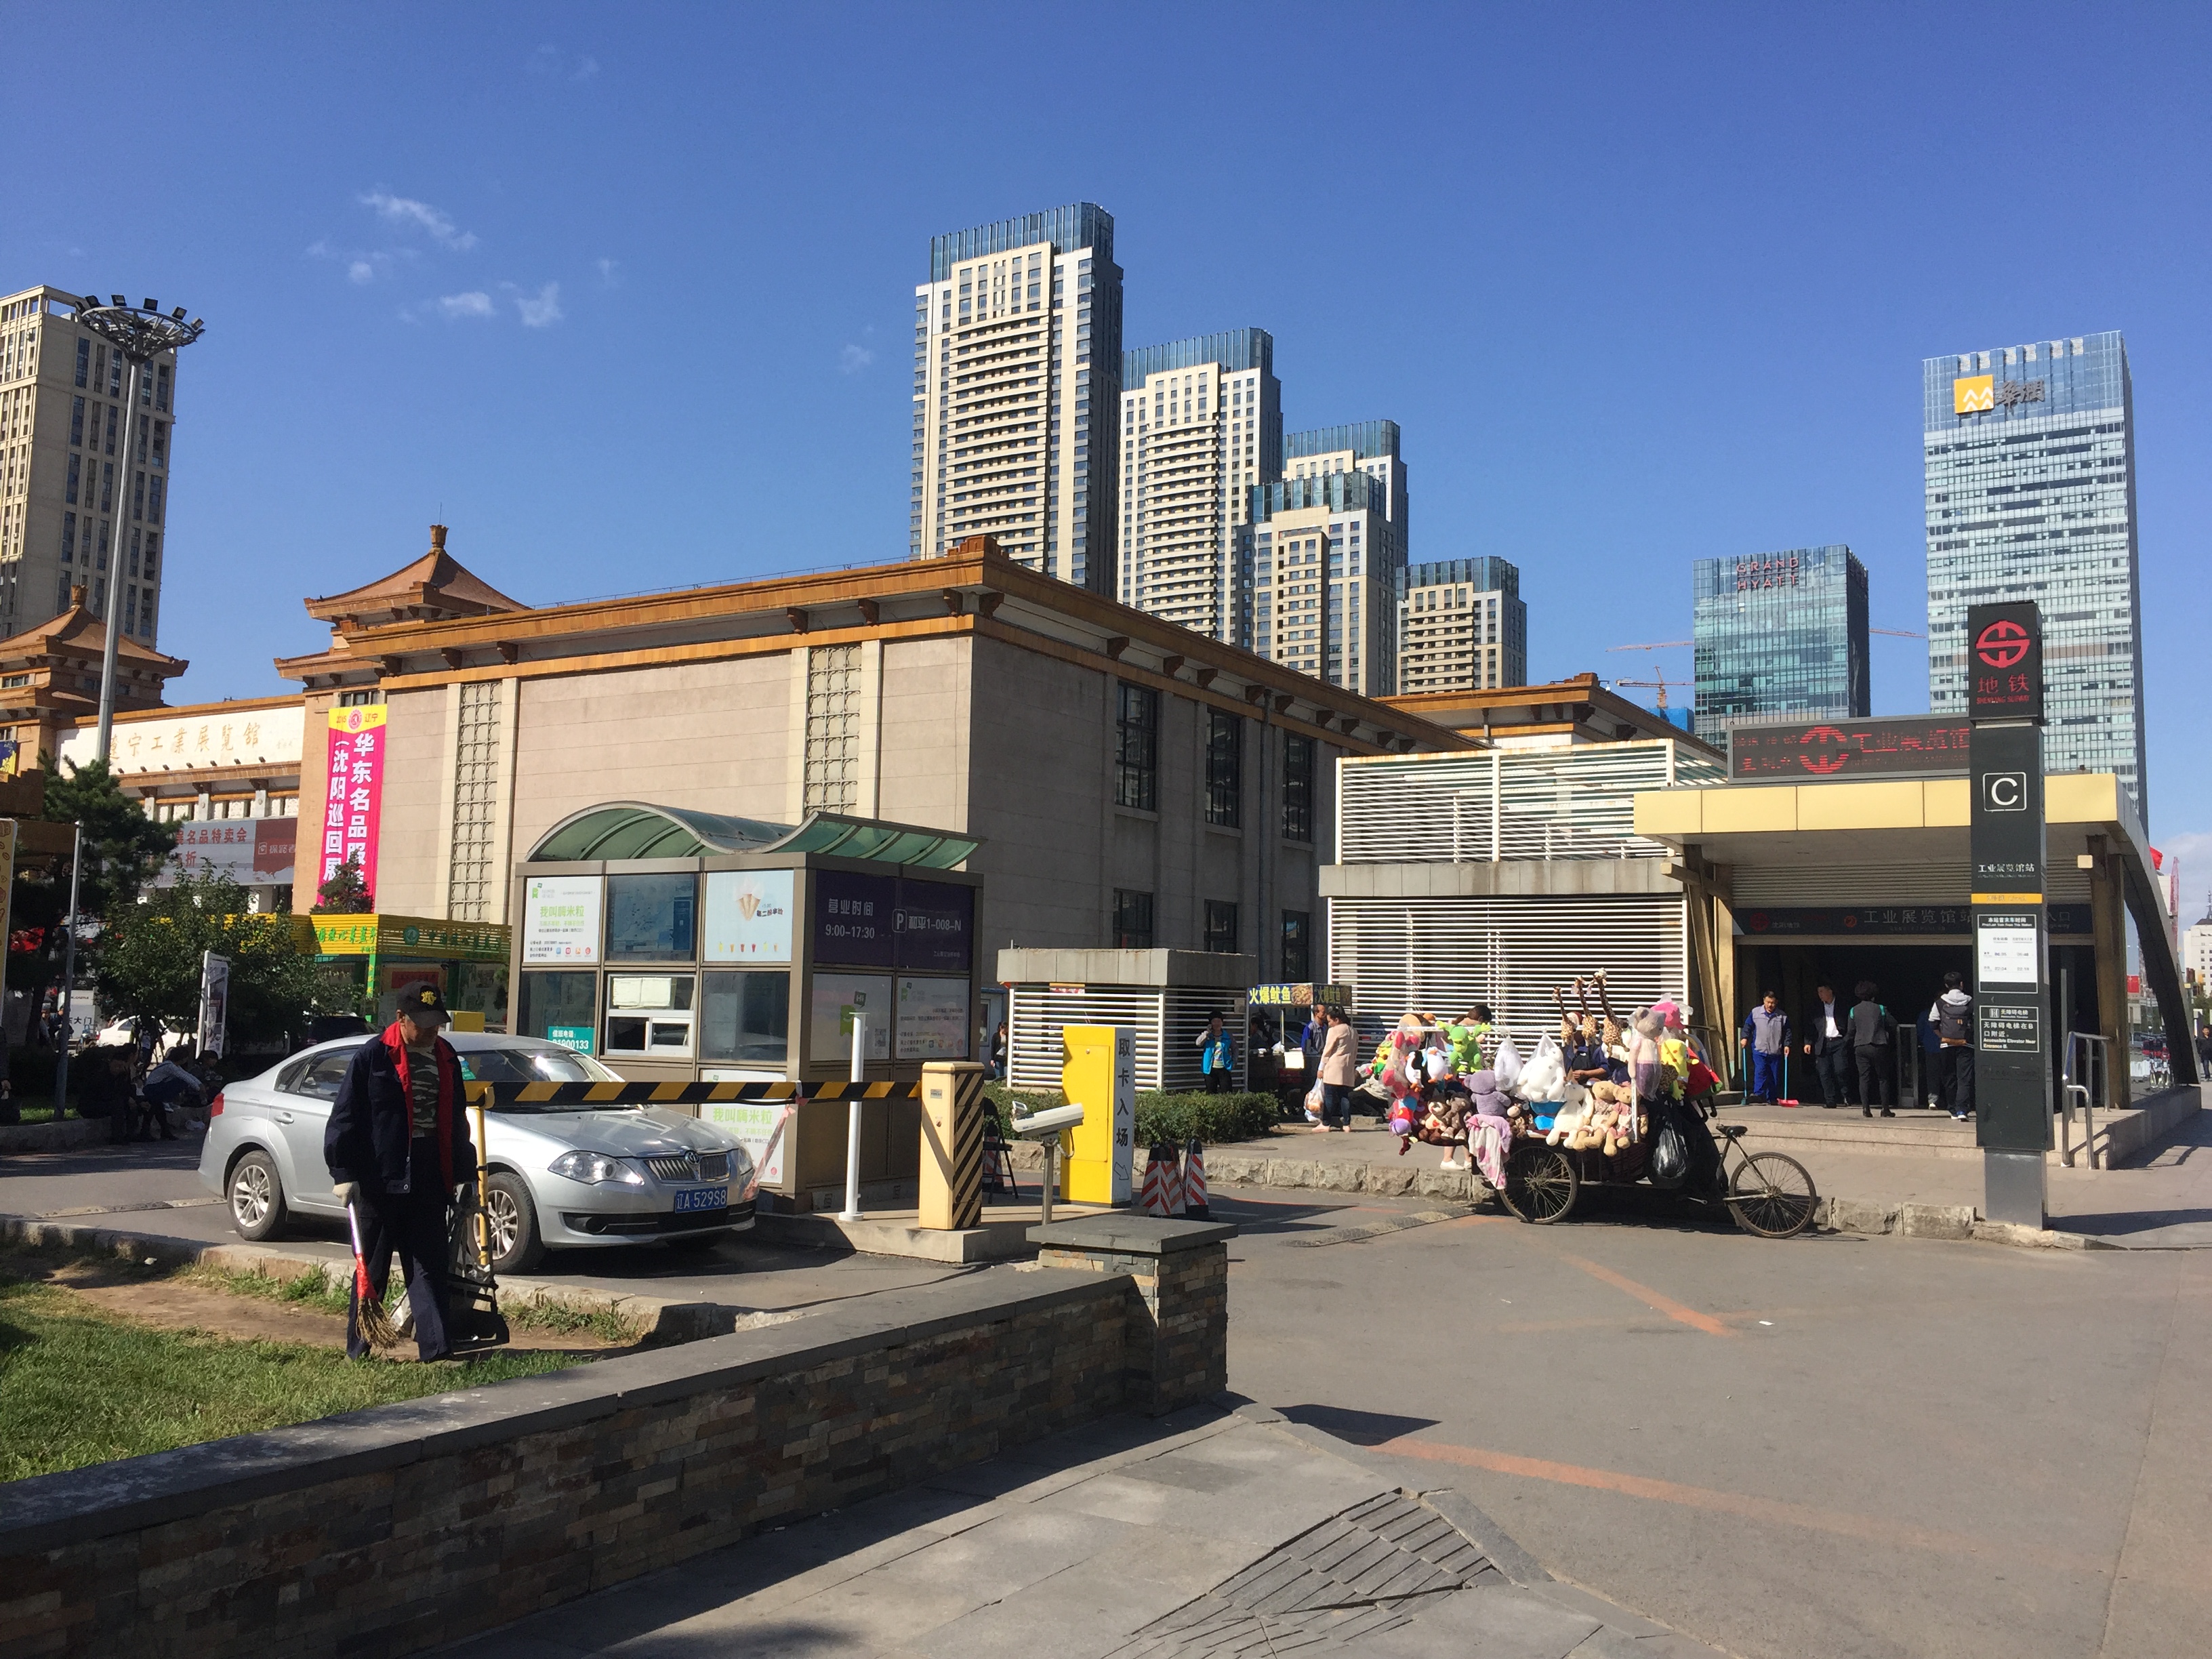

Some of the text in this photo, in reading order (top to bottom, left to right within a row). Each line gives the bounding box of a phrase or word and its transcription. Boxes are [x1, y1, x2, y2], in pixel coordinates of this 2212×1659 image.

[1736, 558, 1799, 573] GRAND
[1738, 575, 1797, 590] HYATT
[1978, 673, 2029, 693] 地铁
[1991, 777, 2018, 805] C
[346, 733, 375, 884] 华东名品服
[1978, 863, 2035, 873] 工业展览馆站
[539, 905, 584, 918] 我叫嗨米粒
[828, 898, 874, 916] 营业时间
[825, 924, 875, 939] 9:00-17:30
[908, 915, 962, 931] 和平1-008-N
[1249, 985, 1292, 1004] 火爆鱿鱼
[1116, 1038, 1130, 1147] 取卡入场
[713, 1107, 773, 1124] 我叫嗨米粒
